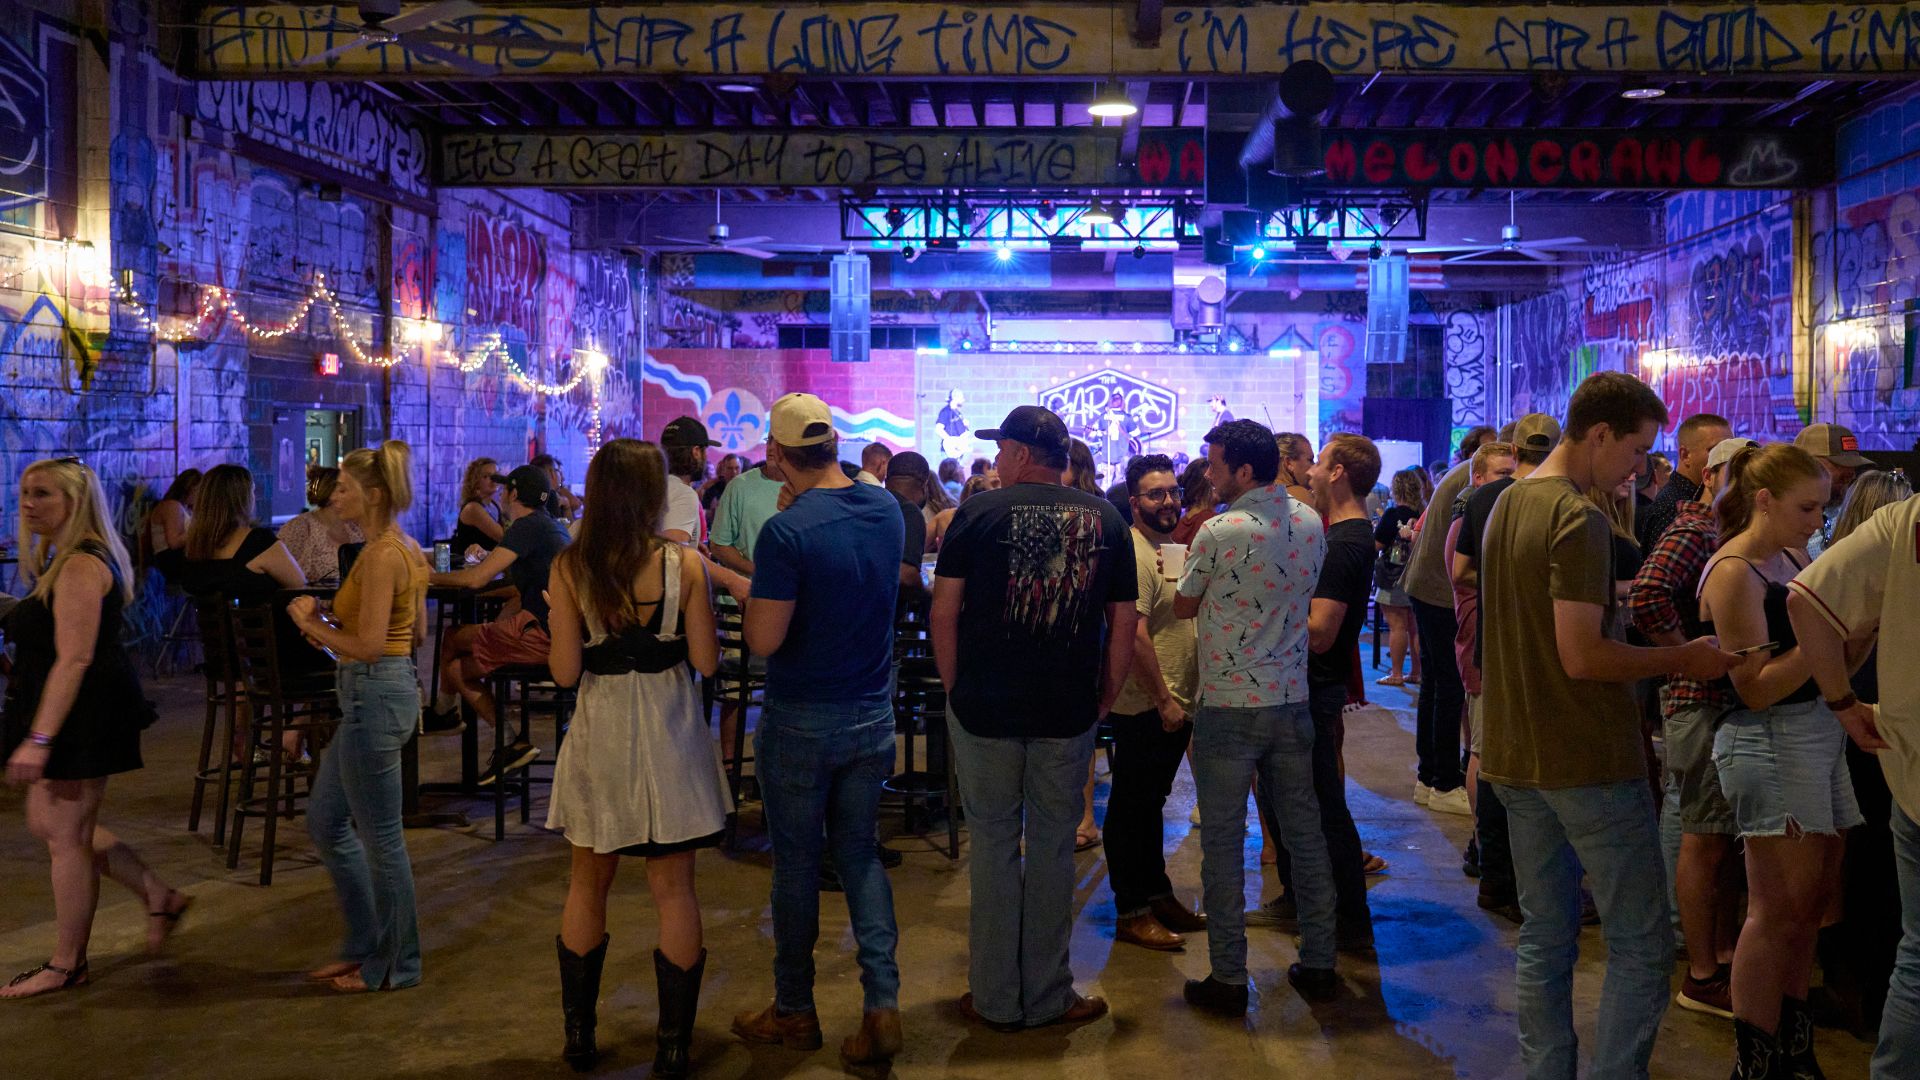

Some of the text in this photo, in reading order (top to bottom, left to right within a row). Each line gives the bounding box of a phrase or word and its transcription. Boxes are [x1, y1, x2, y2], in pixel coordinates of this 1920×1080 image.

[705, 13, 746, 74] A
[769, 10, 902, 73] LONG
[1278, 9, 1459, 72] HERE
[1596, 18, 1639, 68] A
[1656, 6, 1803, 71] GOOD
[532, 138, 558, 178] A
[697, 135, 788, 181] DAY
[1011, 504, 1051, 512] HOWITZER
